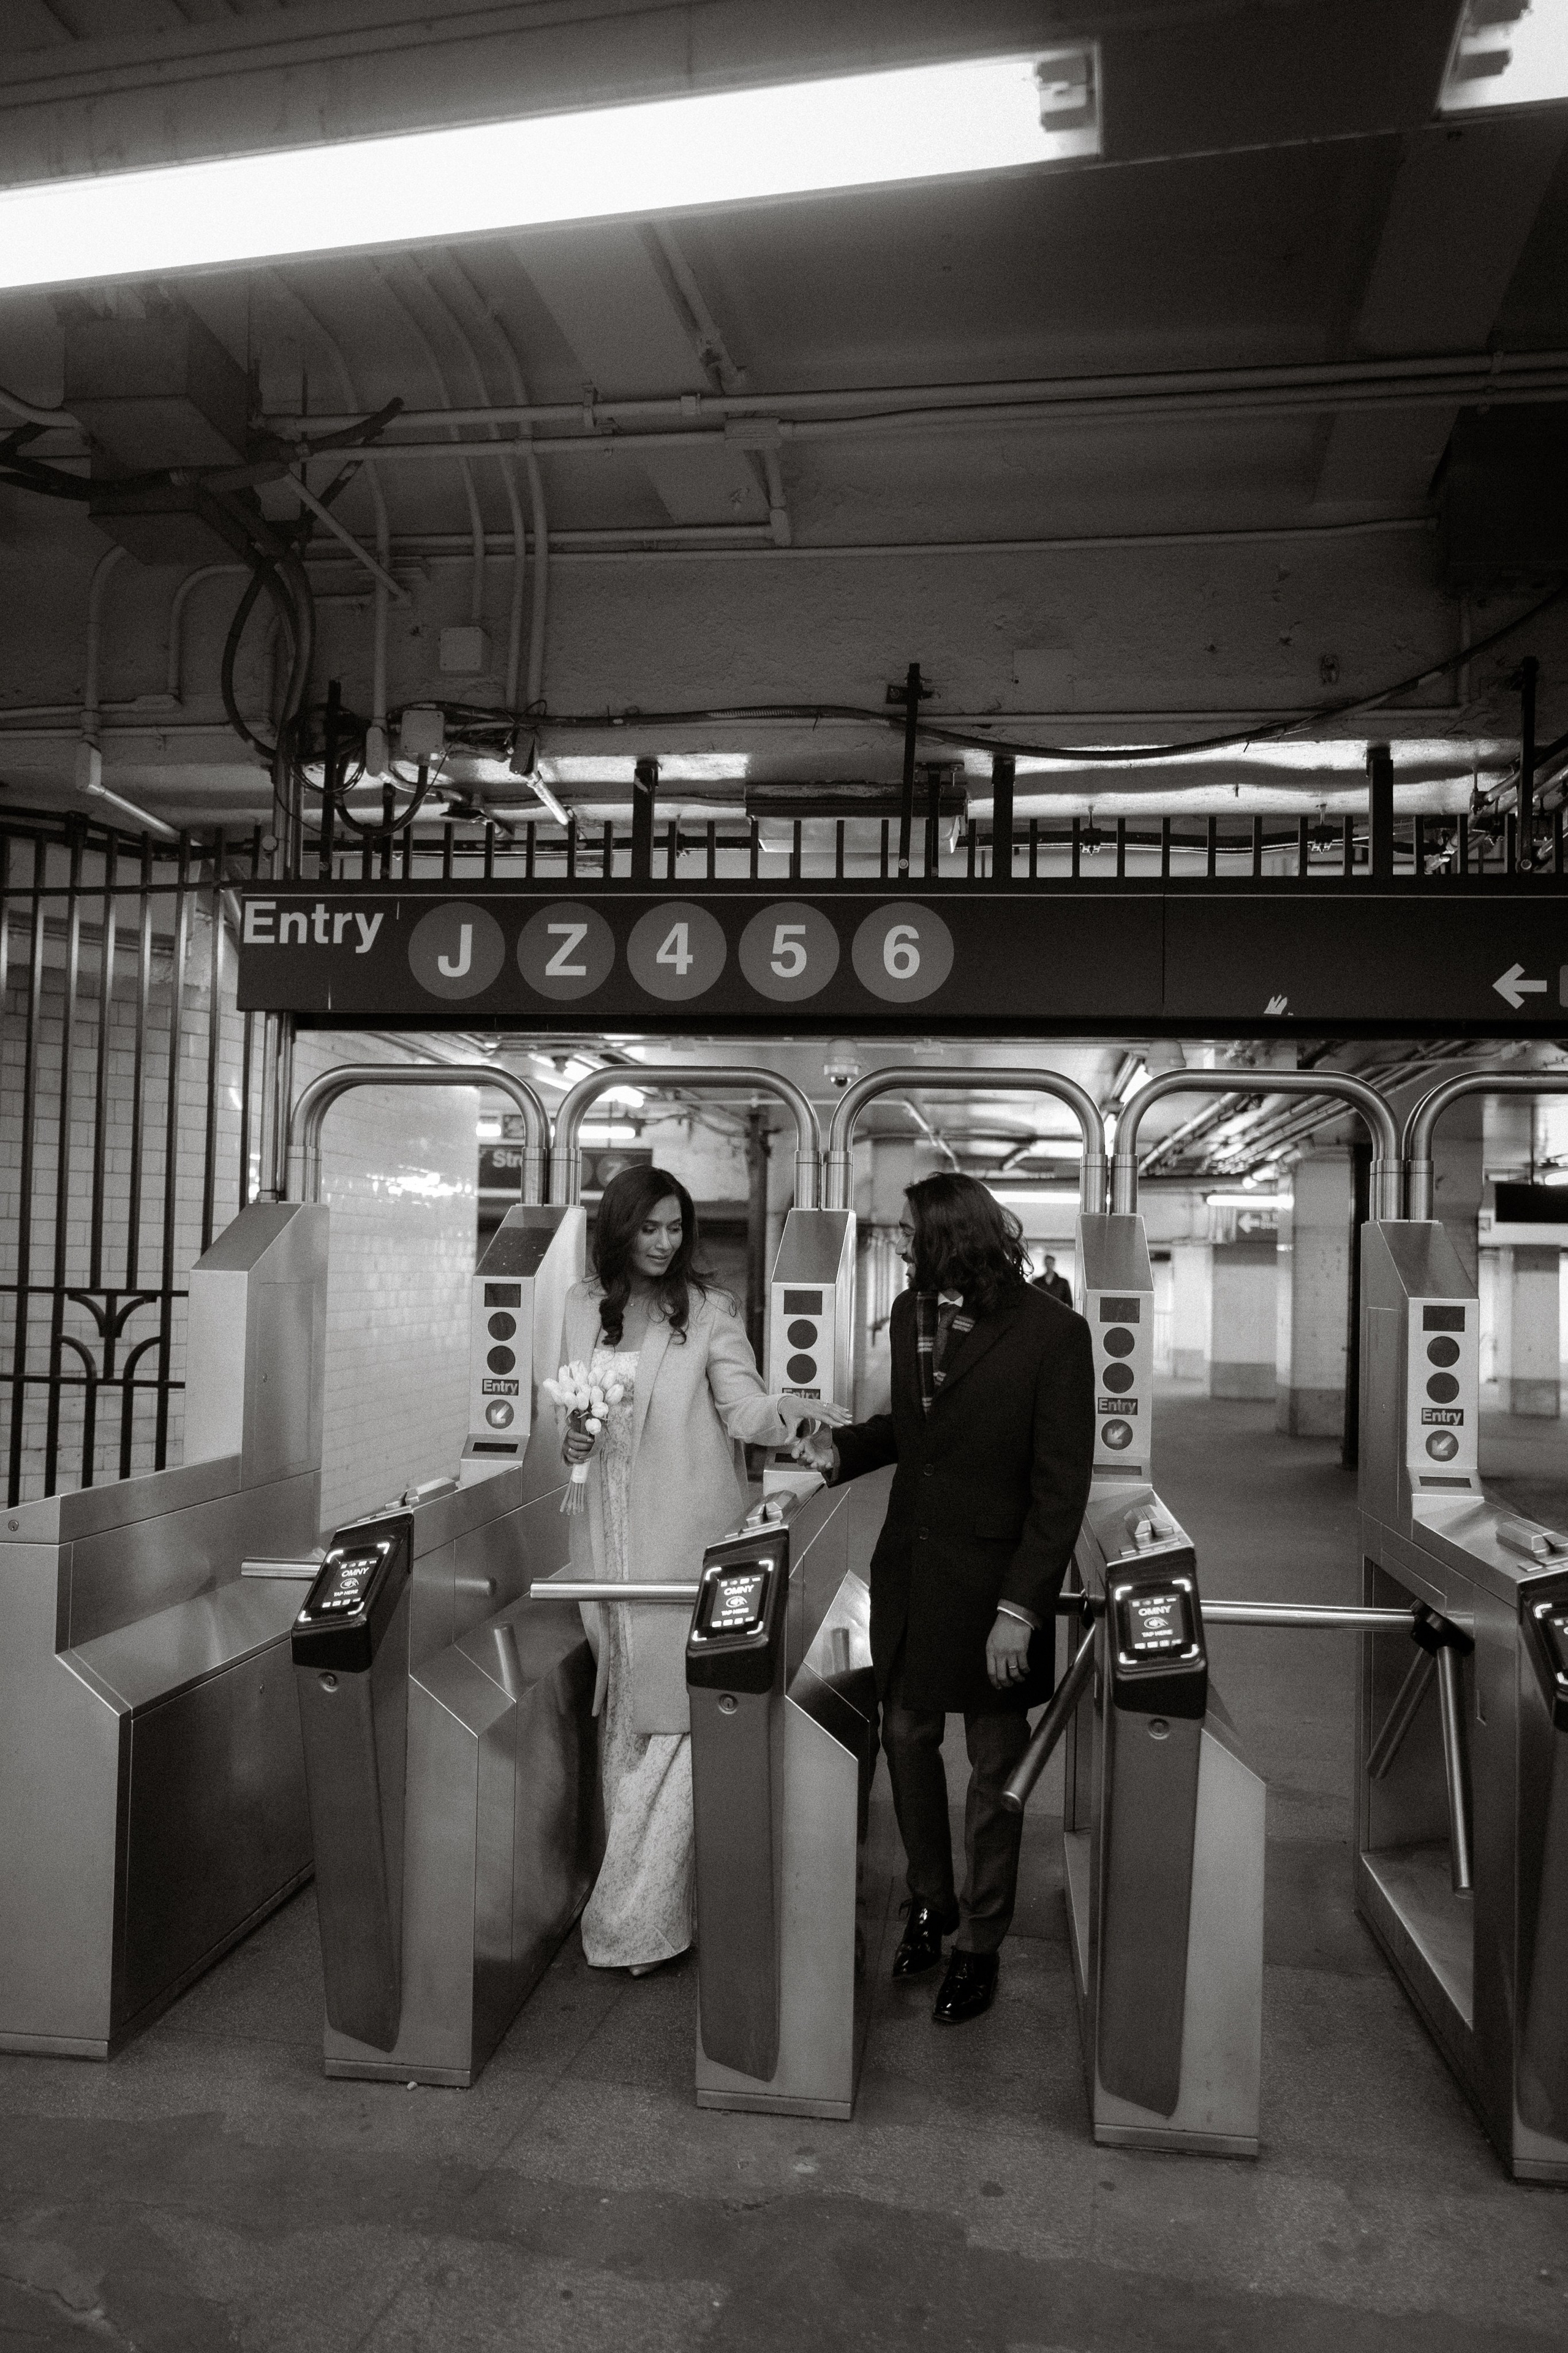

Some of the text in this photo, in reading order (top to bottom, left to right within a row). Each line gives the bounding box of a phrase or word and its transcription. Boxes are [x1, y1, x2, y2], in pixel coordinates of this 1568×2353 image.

[243, 901, 921, 979] Entry J Z 4 5 6
[483, 1380, 518, 1395] Entry
[1098, 1398, 1137, 1414] Entry
[1422, 1409, 1462, 1426] Entry
[341, 1566, 370, 1577] OMNY
[723, 1584, 755, 1596] OMNY
[1138, 1605, 1172, 1616] OMNY
